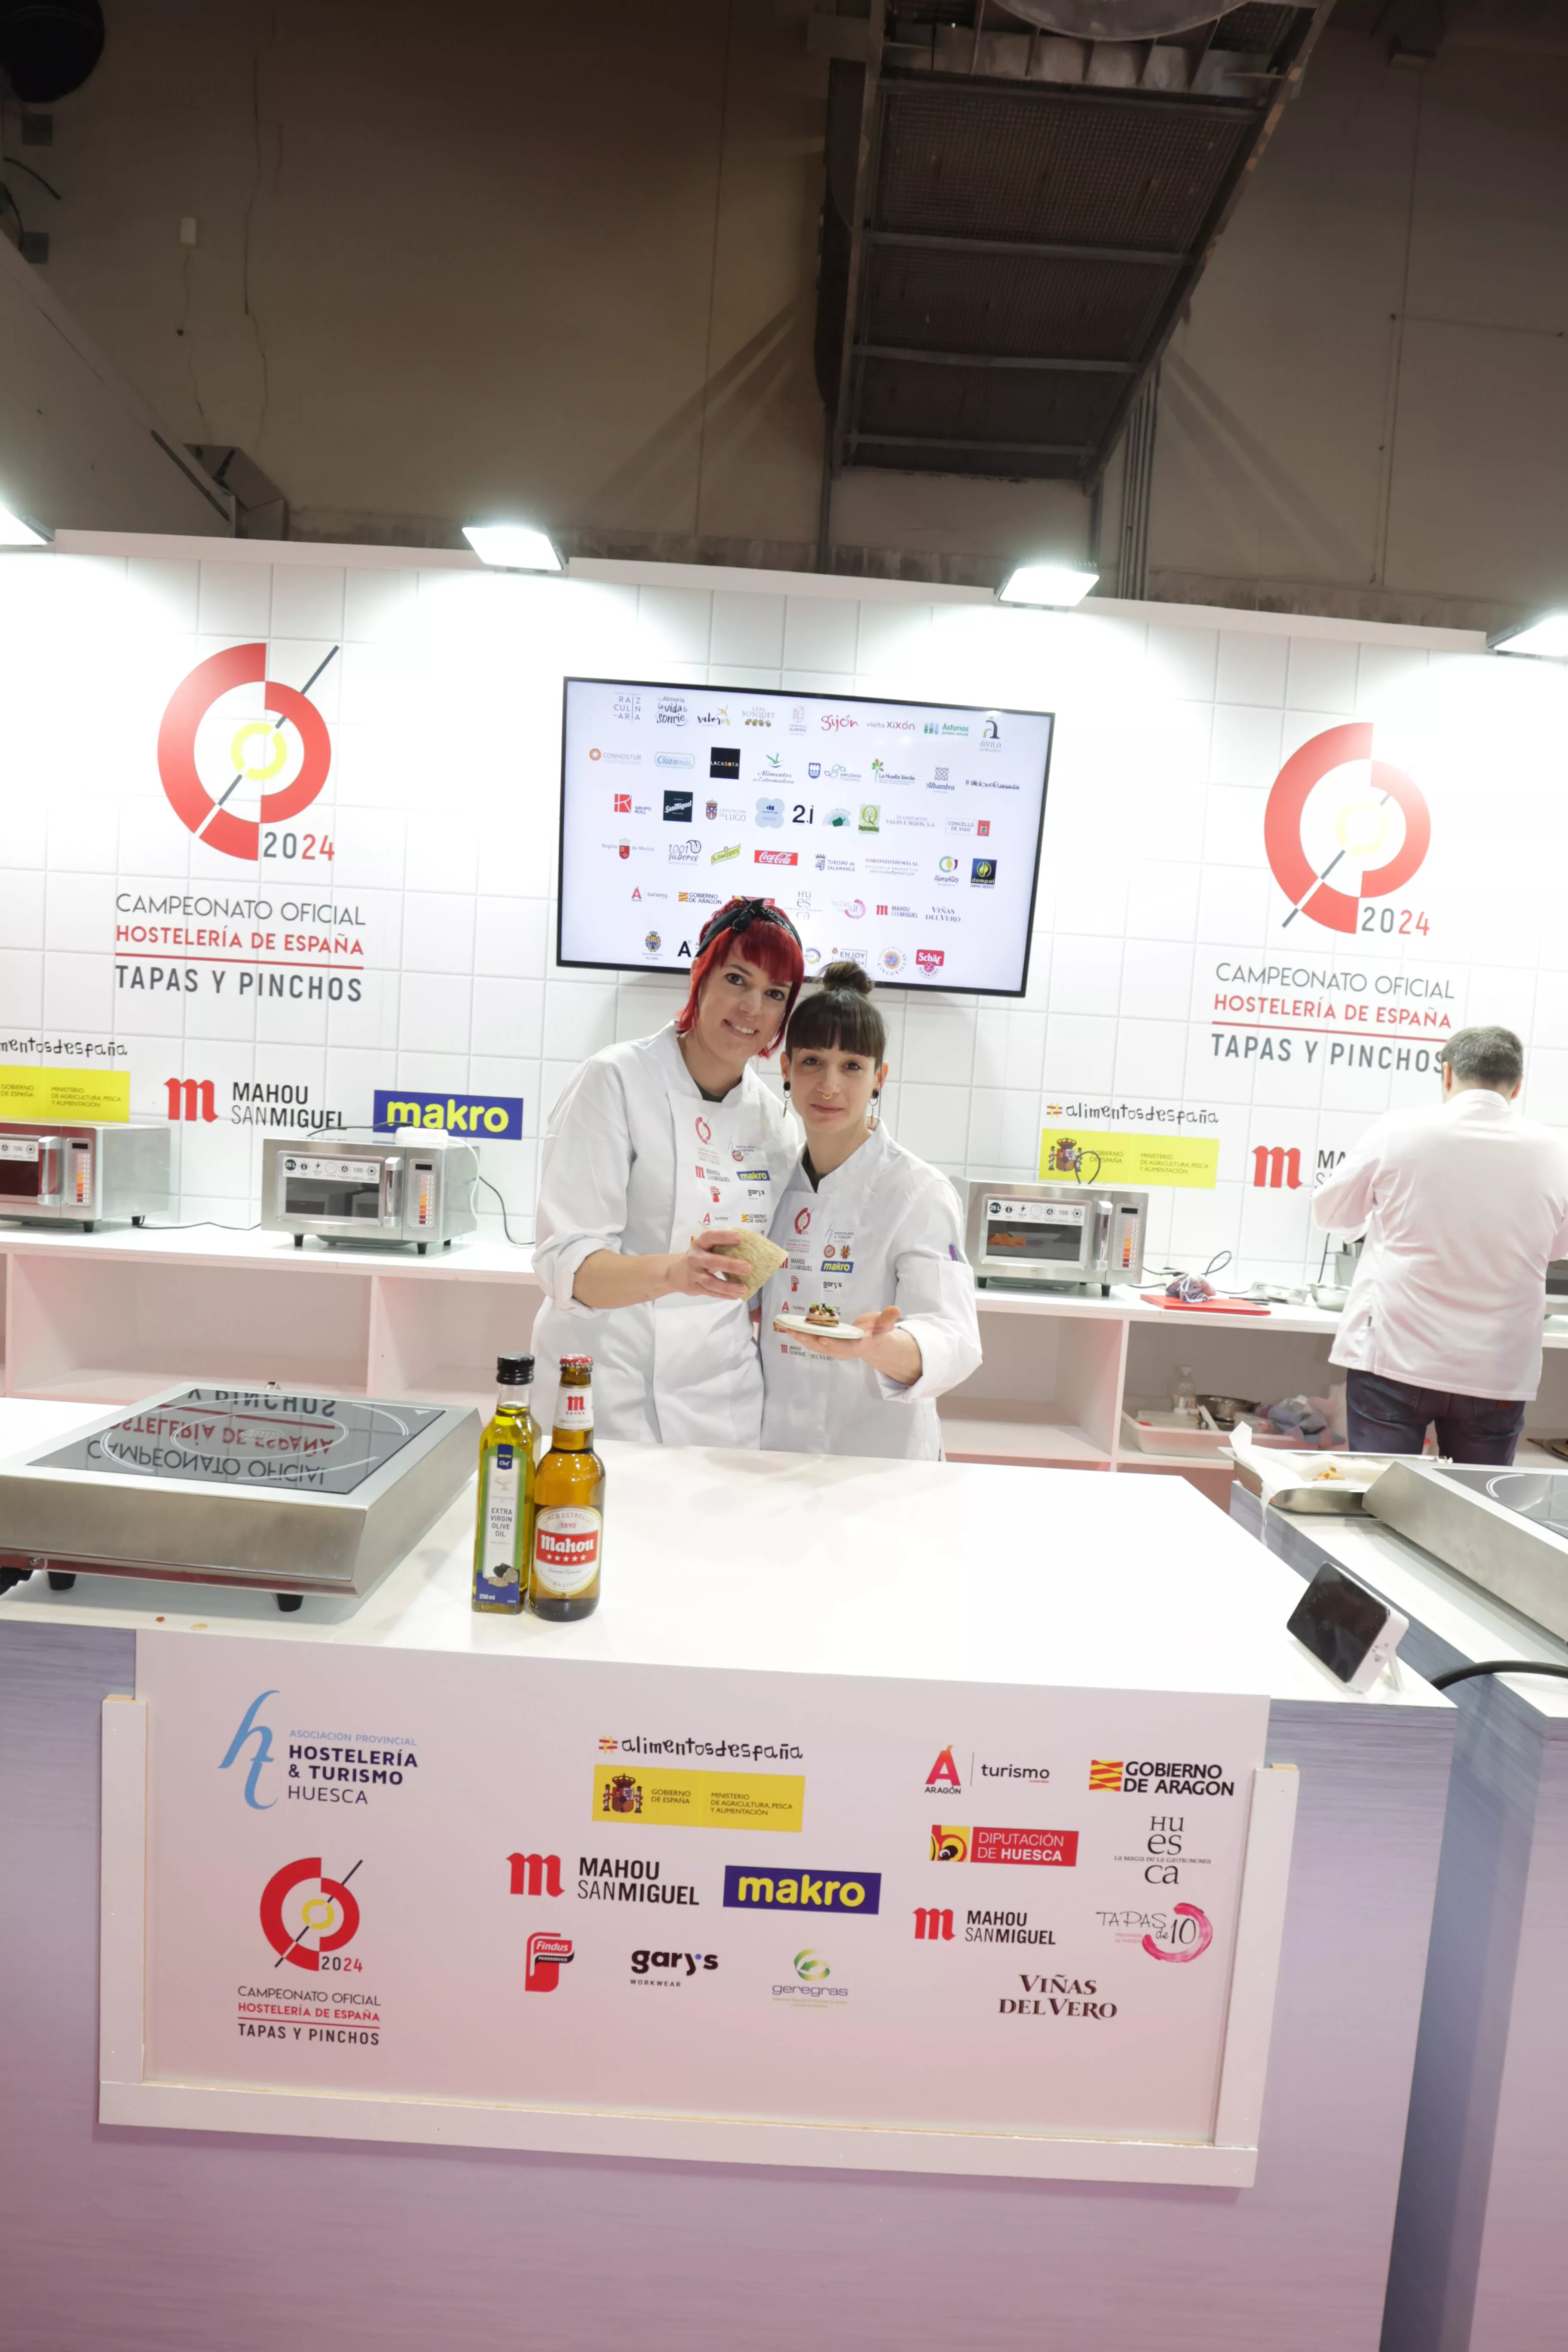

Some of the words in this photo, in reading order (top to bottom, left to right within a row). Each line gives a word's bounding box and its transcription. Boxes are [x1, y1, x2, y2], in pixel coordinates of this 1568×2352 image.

[942, 723, 969, 732] Asturias
[926, 782, 955, 790] Alhambra
[263, 832, 335, 861] 2024
[116, 894, 272, 919] CAMPEONATO
[281, 902, 366, 925] OFICIAL
[1361, 906, 1430, 936] 2024
[116, 925, 242, 948] HOSTELERÍA
[251, 932, 276, 949] DE
[285, 933, 364, 955] ESPAÑA
[919, 952, 942, 964] Schär
[115, 965, 198, 992] TAPAS
[212, 971, 226, 993] Y
[239, 973, 361, 1002] PINCHOS
[1216, 963, 1367, 992] CAMPEONATO
[1375, 976, 1455, 999] OFICIAL
[1214, 994, 1336, 1019] HOSTELERÍA
[1344, 1004, 1368, 1021] DE
[1376, 1006, 1451, 1028] ESPAÑA
[1211, 1033, 1292, 1062] TAPAS
[1305, 1040, 1318, 1063] Y
[233, 1083, 308, 1104] MAHOU
[231, 1107, 346, 1130] SANMIGUEL
[388, 1099, 508, 1132] makro
[740, 1171, 767, 1179] makro
[824, 1262, 850, 1271] makro
[543, 1513, 559, 1524] CINCO
[561, 1513, 594, 1525] ESTRELLAS
[541, 1534, 594, 1553] Mahou
[290, 1730, 352, 1742] ASOCIACIÓN
[356, 1734, 417, 1746] PROVINCIAL
[289, 1745, 418, 1767] HOSTELERÍA
[289, 1764, 300, 1778] &
[309, 1765, 403, 1785] TURISMO
[981, 1764, 1050, 1780] turismo
[1126, 1761, 1222, 1779] GOBIERNO
[288, 1785, 368, 1804] HUESCA
[925, 1786, 961, 1795] ARAGÓN
[1124, 1778, 1148, 1793] DE
[1155, 1779, 1234, 1796] ARAGON
[663, 1796, 690, 1804] ESPAÑA
[722, 1801, 770, 1809] AGRICULTURA,
[716, 1807, 768, 1816] ALIMENTACIÓN
[979, 1832, 1064, 1847] DIPUTACIÓN
[1147, 1834, 1182, 1855] es
[978, 1847, 996, 1859] DE
[1001, 1848, 1062, 1862] HUESCA
[579, 1857, 660, 1881] MAHOU
[1145, 1865, 1179, 1884] ca
[578, 1880, 699, 1906] SANMIGUEL
[738, 1874, 865, 1907] makro
[967, 1910, 1027, 1926] MAHOU
[1097, 1911, 1166, 1929] TAPAS
[965, 1927, 1056, 1945] SANMIGUEL
[1155, 1928, 1168, 1939] de
[1171, 1918, 1196, 1944] 10
[536, 1941, 569, 1953] Findus
[322, 1956, 363, 1973] 2024
[630, 1979, 681, 1988] WORKWEAR
[772, 1984, 848, 1997] geregras
[1019, 1974, 1096, 1995] VIÑAS
[238, 1985, 328, 2003] CAMPEONATO
[332, 1993, 381, 2006] OFICIAL
[238, 2003, 311, 2017] HOSTELERÍA
[315, 2008, 330, 2018] DE
[334, 2009, 380, 2021] ESPAÑA
[238, 2023, 286, 2040] TAPAS
[294, 2027, 301, 2040] Y
[309, 2028, 380, 2046] PINCHOS
